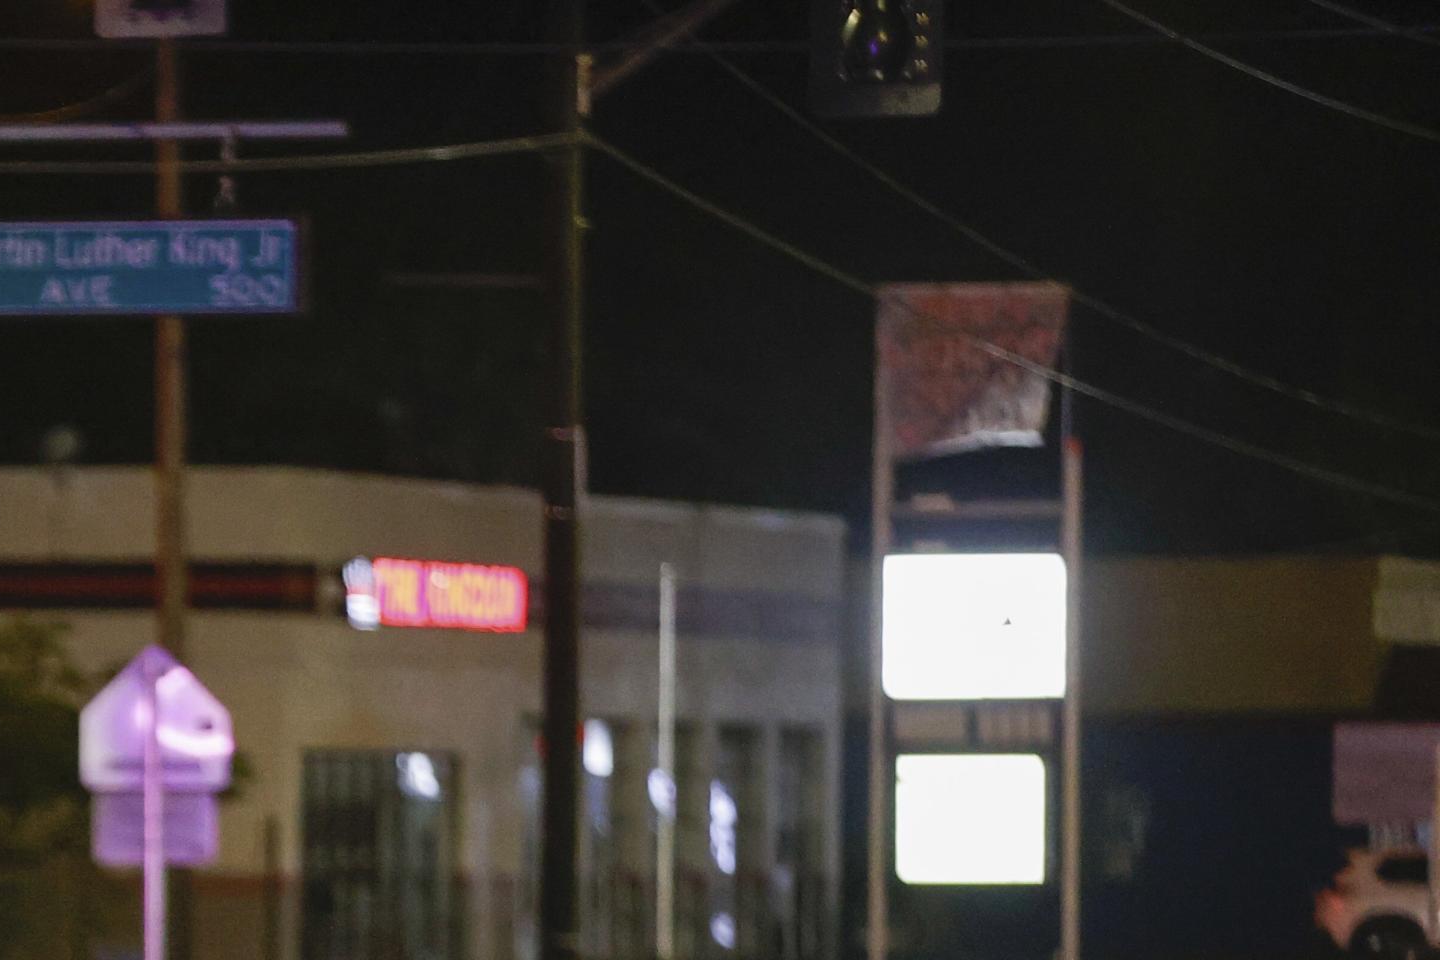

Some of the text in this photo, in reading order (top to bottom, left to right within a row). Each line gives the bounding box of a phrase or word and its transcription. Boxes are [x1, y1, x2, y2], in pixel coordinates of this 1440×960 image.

[55, 230, 158, 268] Luther
[169, 229, 241, 272] King
[40, 276, 112, 307] AVE
